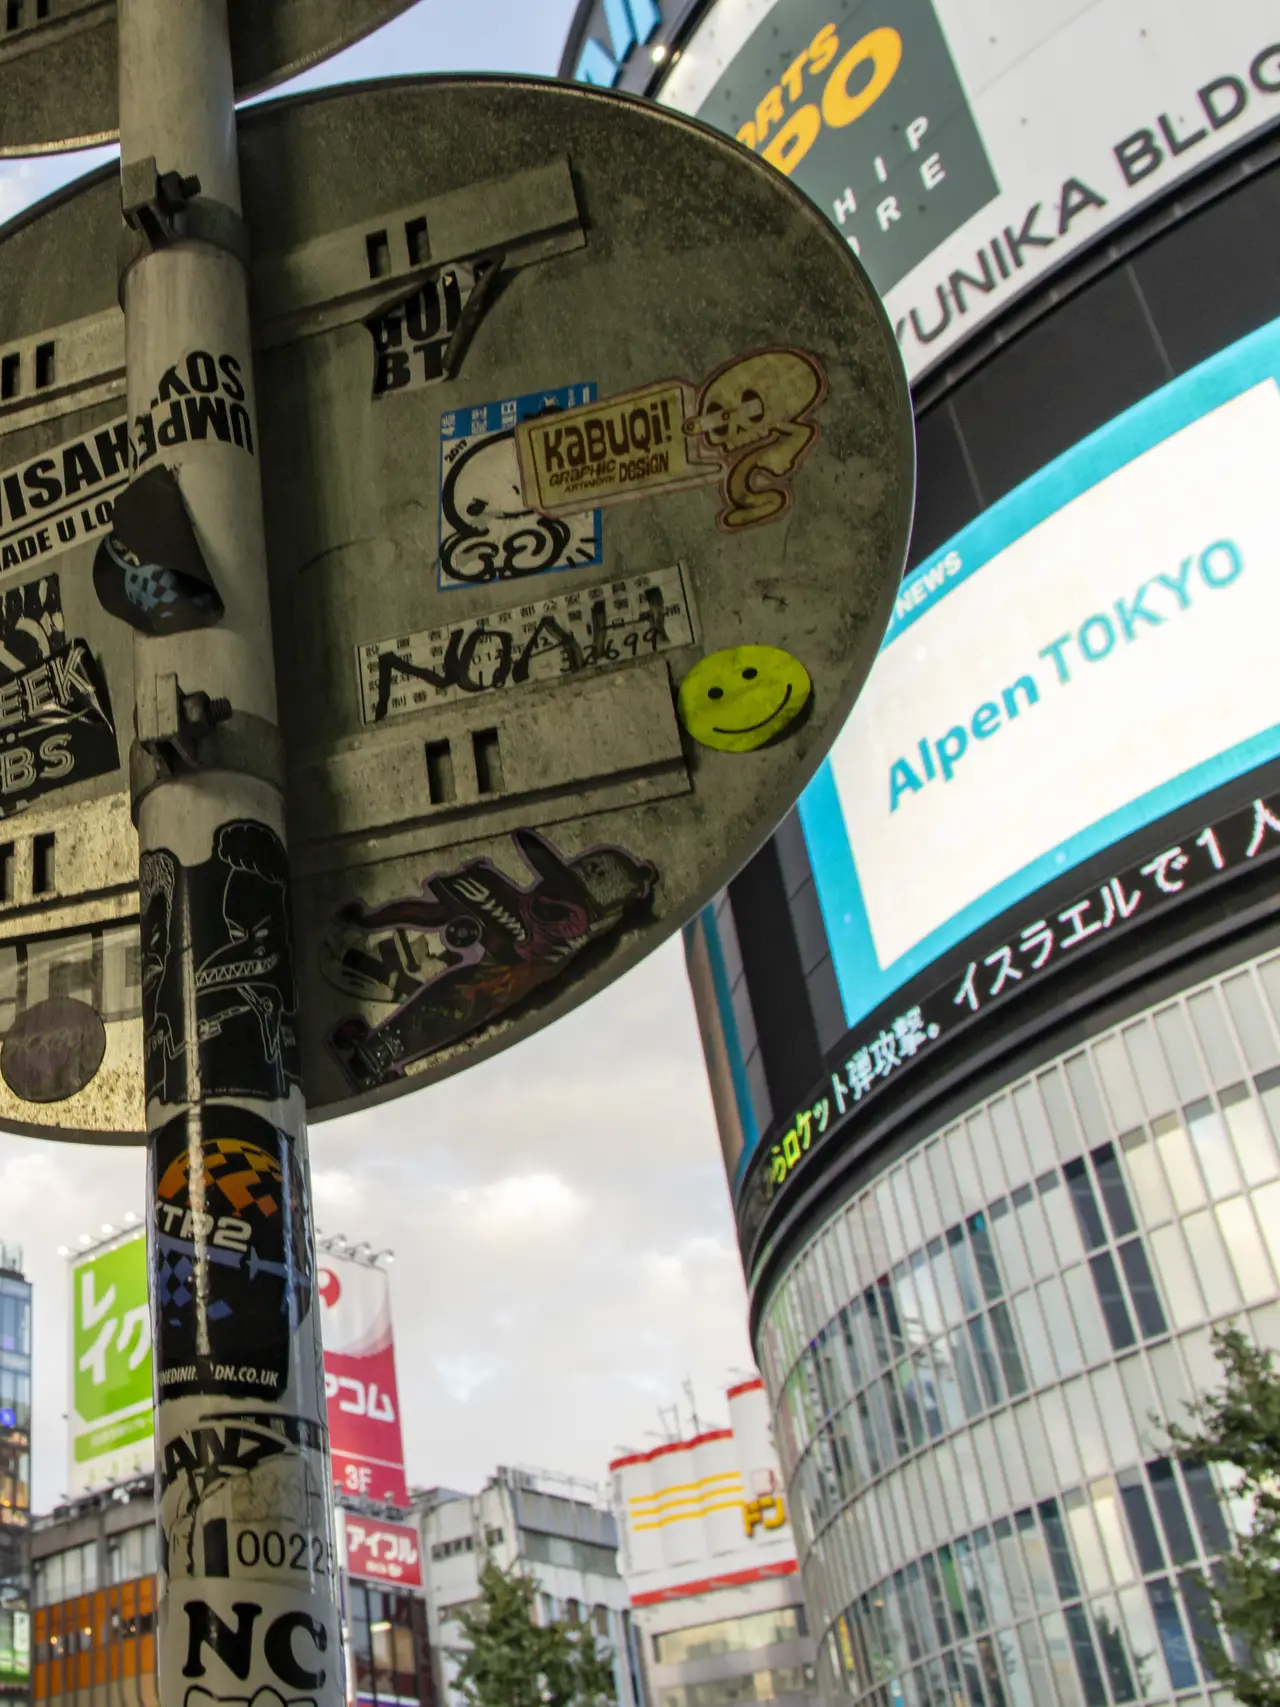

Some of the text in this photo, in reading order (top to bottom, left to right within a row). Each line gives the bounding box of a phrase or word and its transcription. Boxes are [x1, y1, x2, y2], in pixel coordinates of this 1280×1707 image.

[55, 515, 77, 543] U
[896, 551, 962, 620] NEWS
[887, 537, 1245, 814] Alpen TOKYO
[345, 1523, 419, 1565] アイフル
